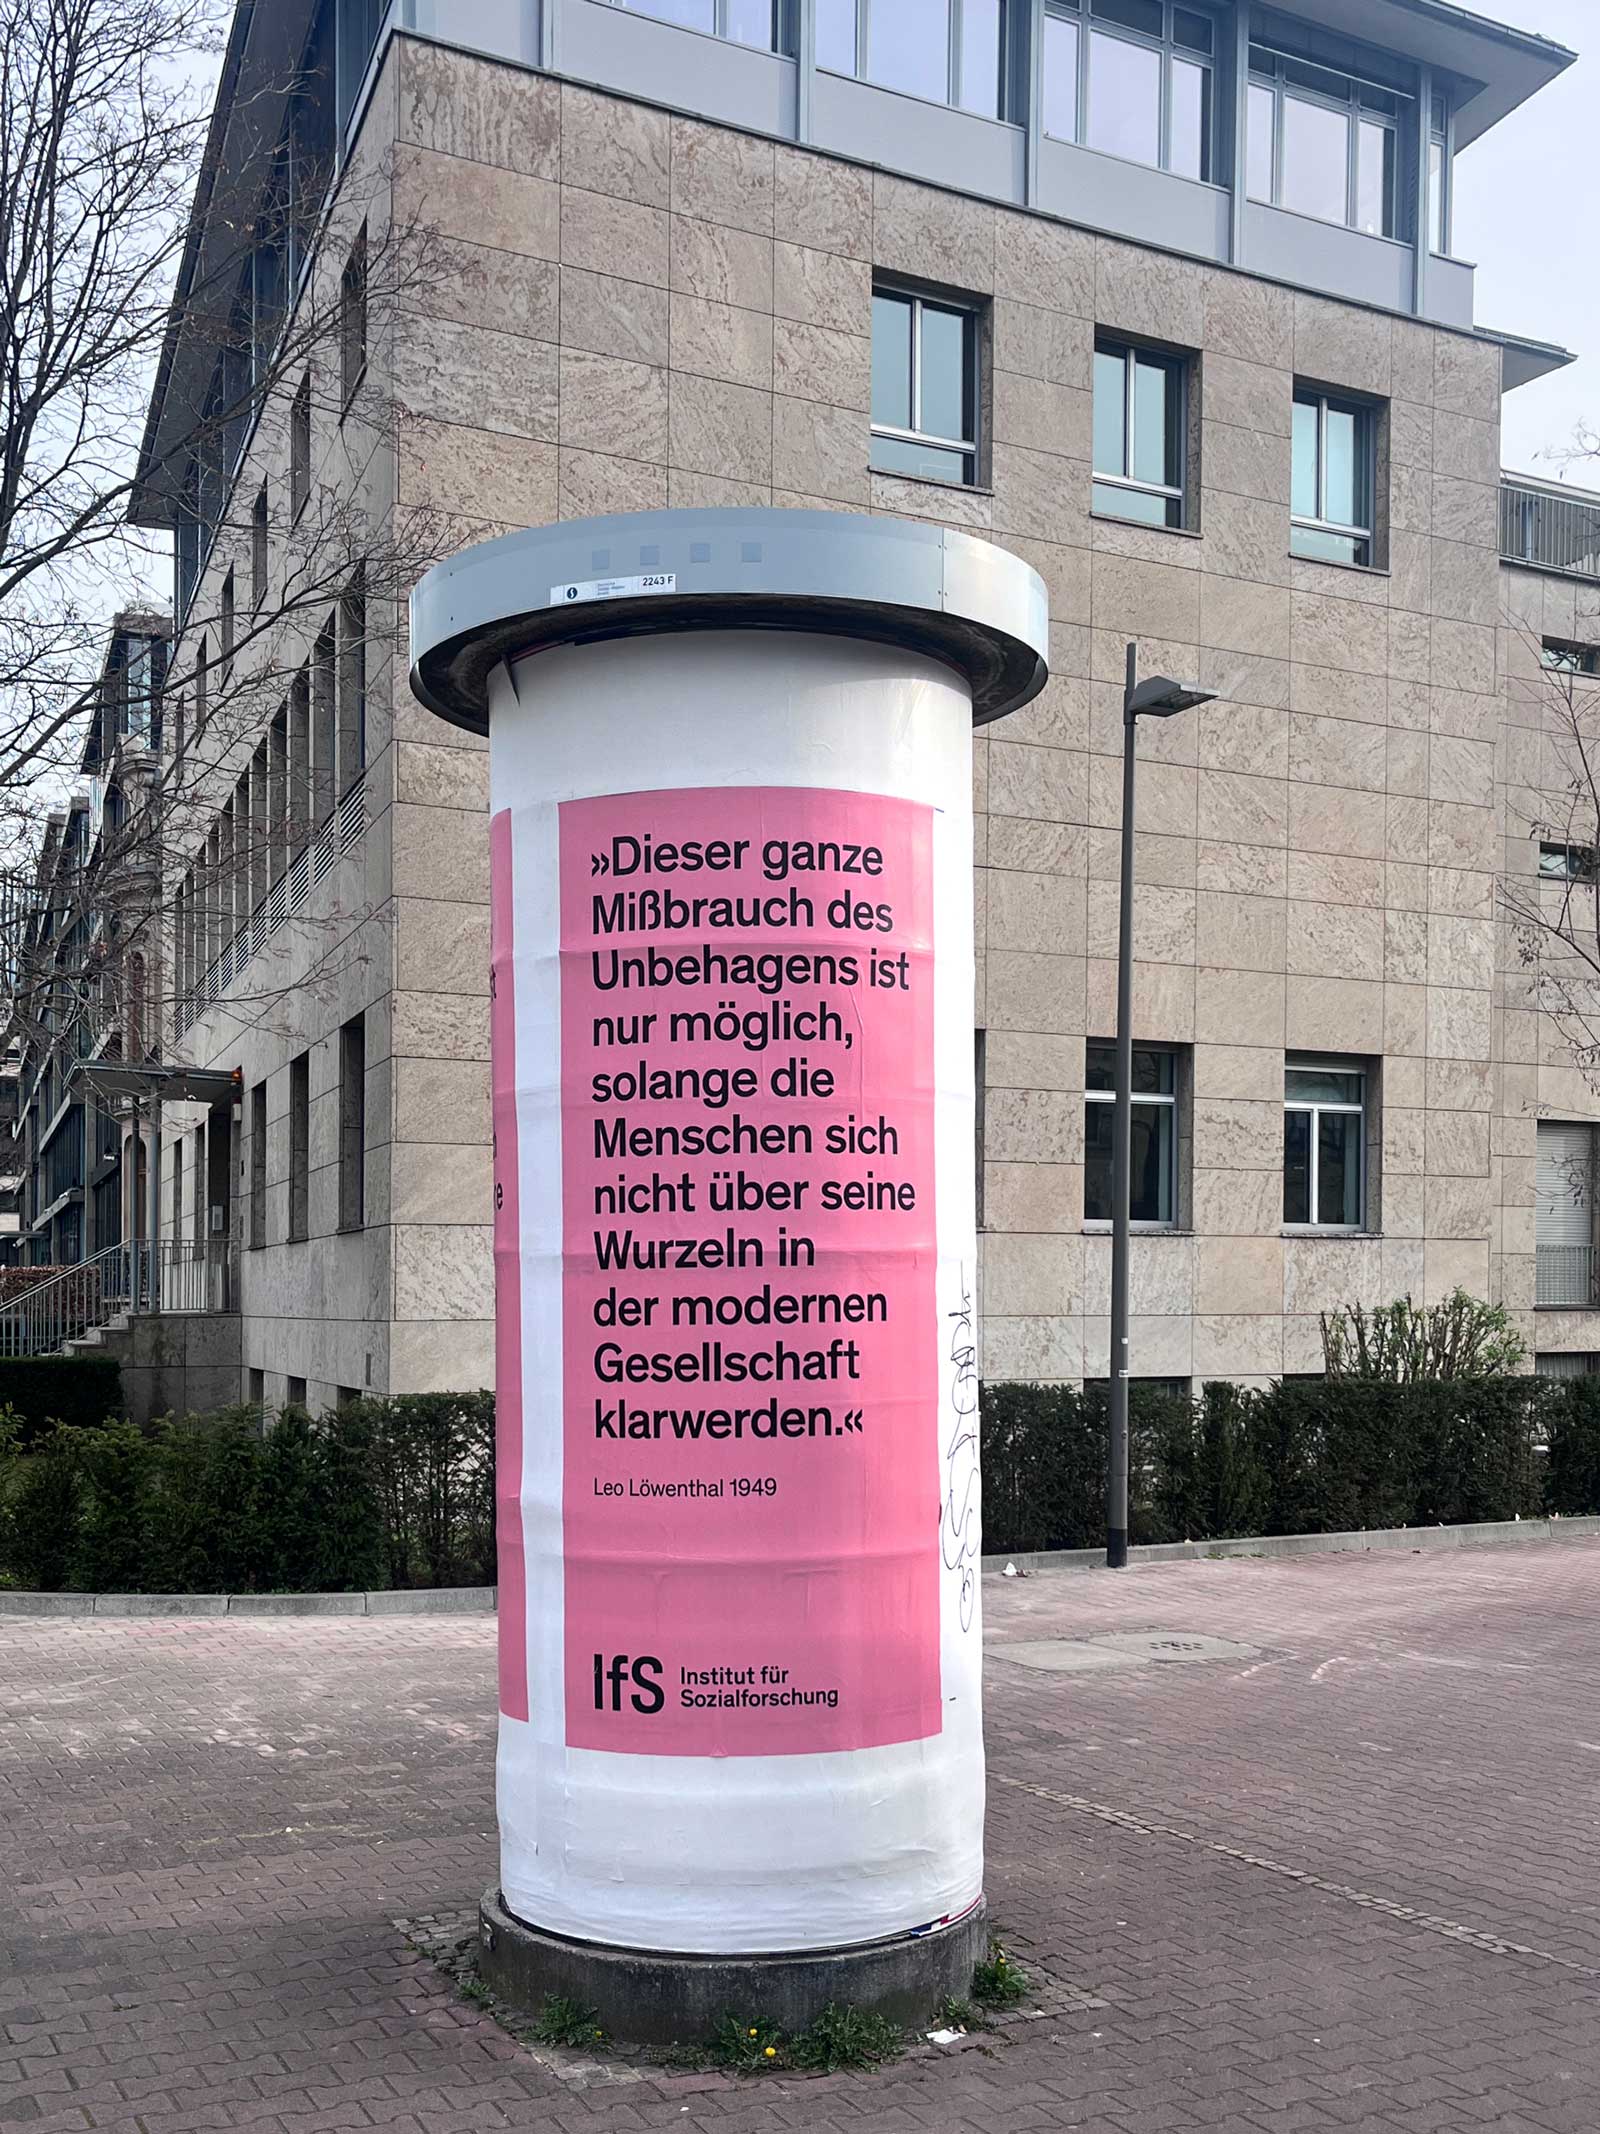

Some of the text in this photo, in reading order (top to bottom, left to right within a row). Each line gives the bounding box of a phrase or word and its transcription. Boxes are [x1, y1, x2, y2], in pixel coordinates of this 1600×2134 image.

[642, 575, 674, 587] 2243 F
[591, 833, 883, 881] »Dieser ganze
[592, 886, 893, 935] Mißbrauch des
[591, 943, 910, 995] Unbehagens ist
[593, 1000, 853, 1053] nur möglich,
[591, 1056, 835, 1110] solange die
[594, 1113, 898, 1159] Menschen sich
[594, 1169, 916, 1215] nicht über seine
[593, 1226, 815, 1271] Wurzeln in
[593, 1284, 887, 1328] der modernen
[593, 1338, 860, 1383] Gesellschaft
[595, 1397, 863, 1440] klarwerden.«
[594, 1477, 777, 1498] Leo Löwenthal 1949
[593, 1653, 665, 1715] IfS
[680, 1665, 790, 1686] Institut für
[680, 1687, 839, 1708] Sozialforschung
